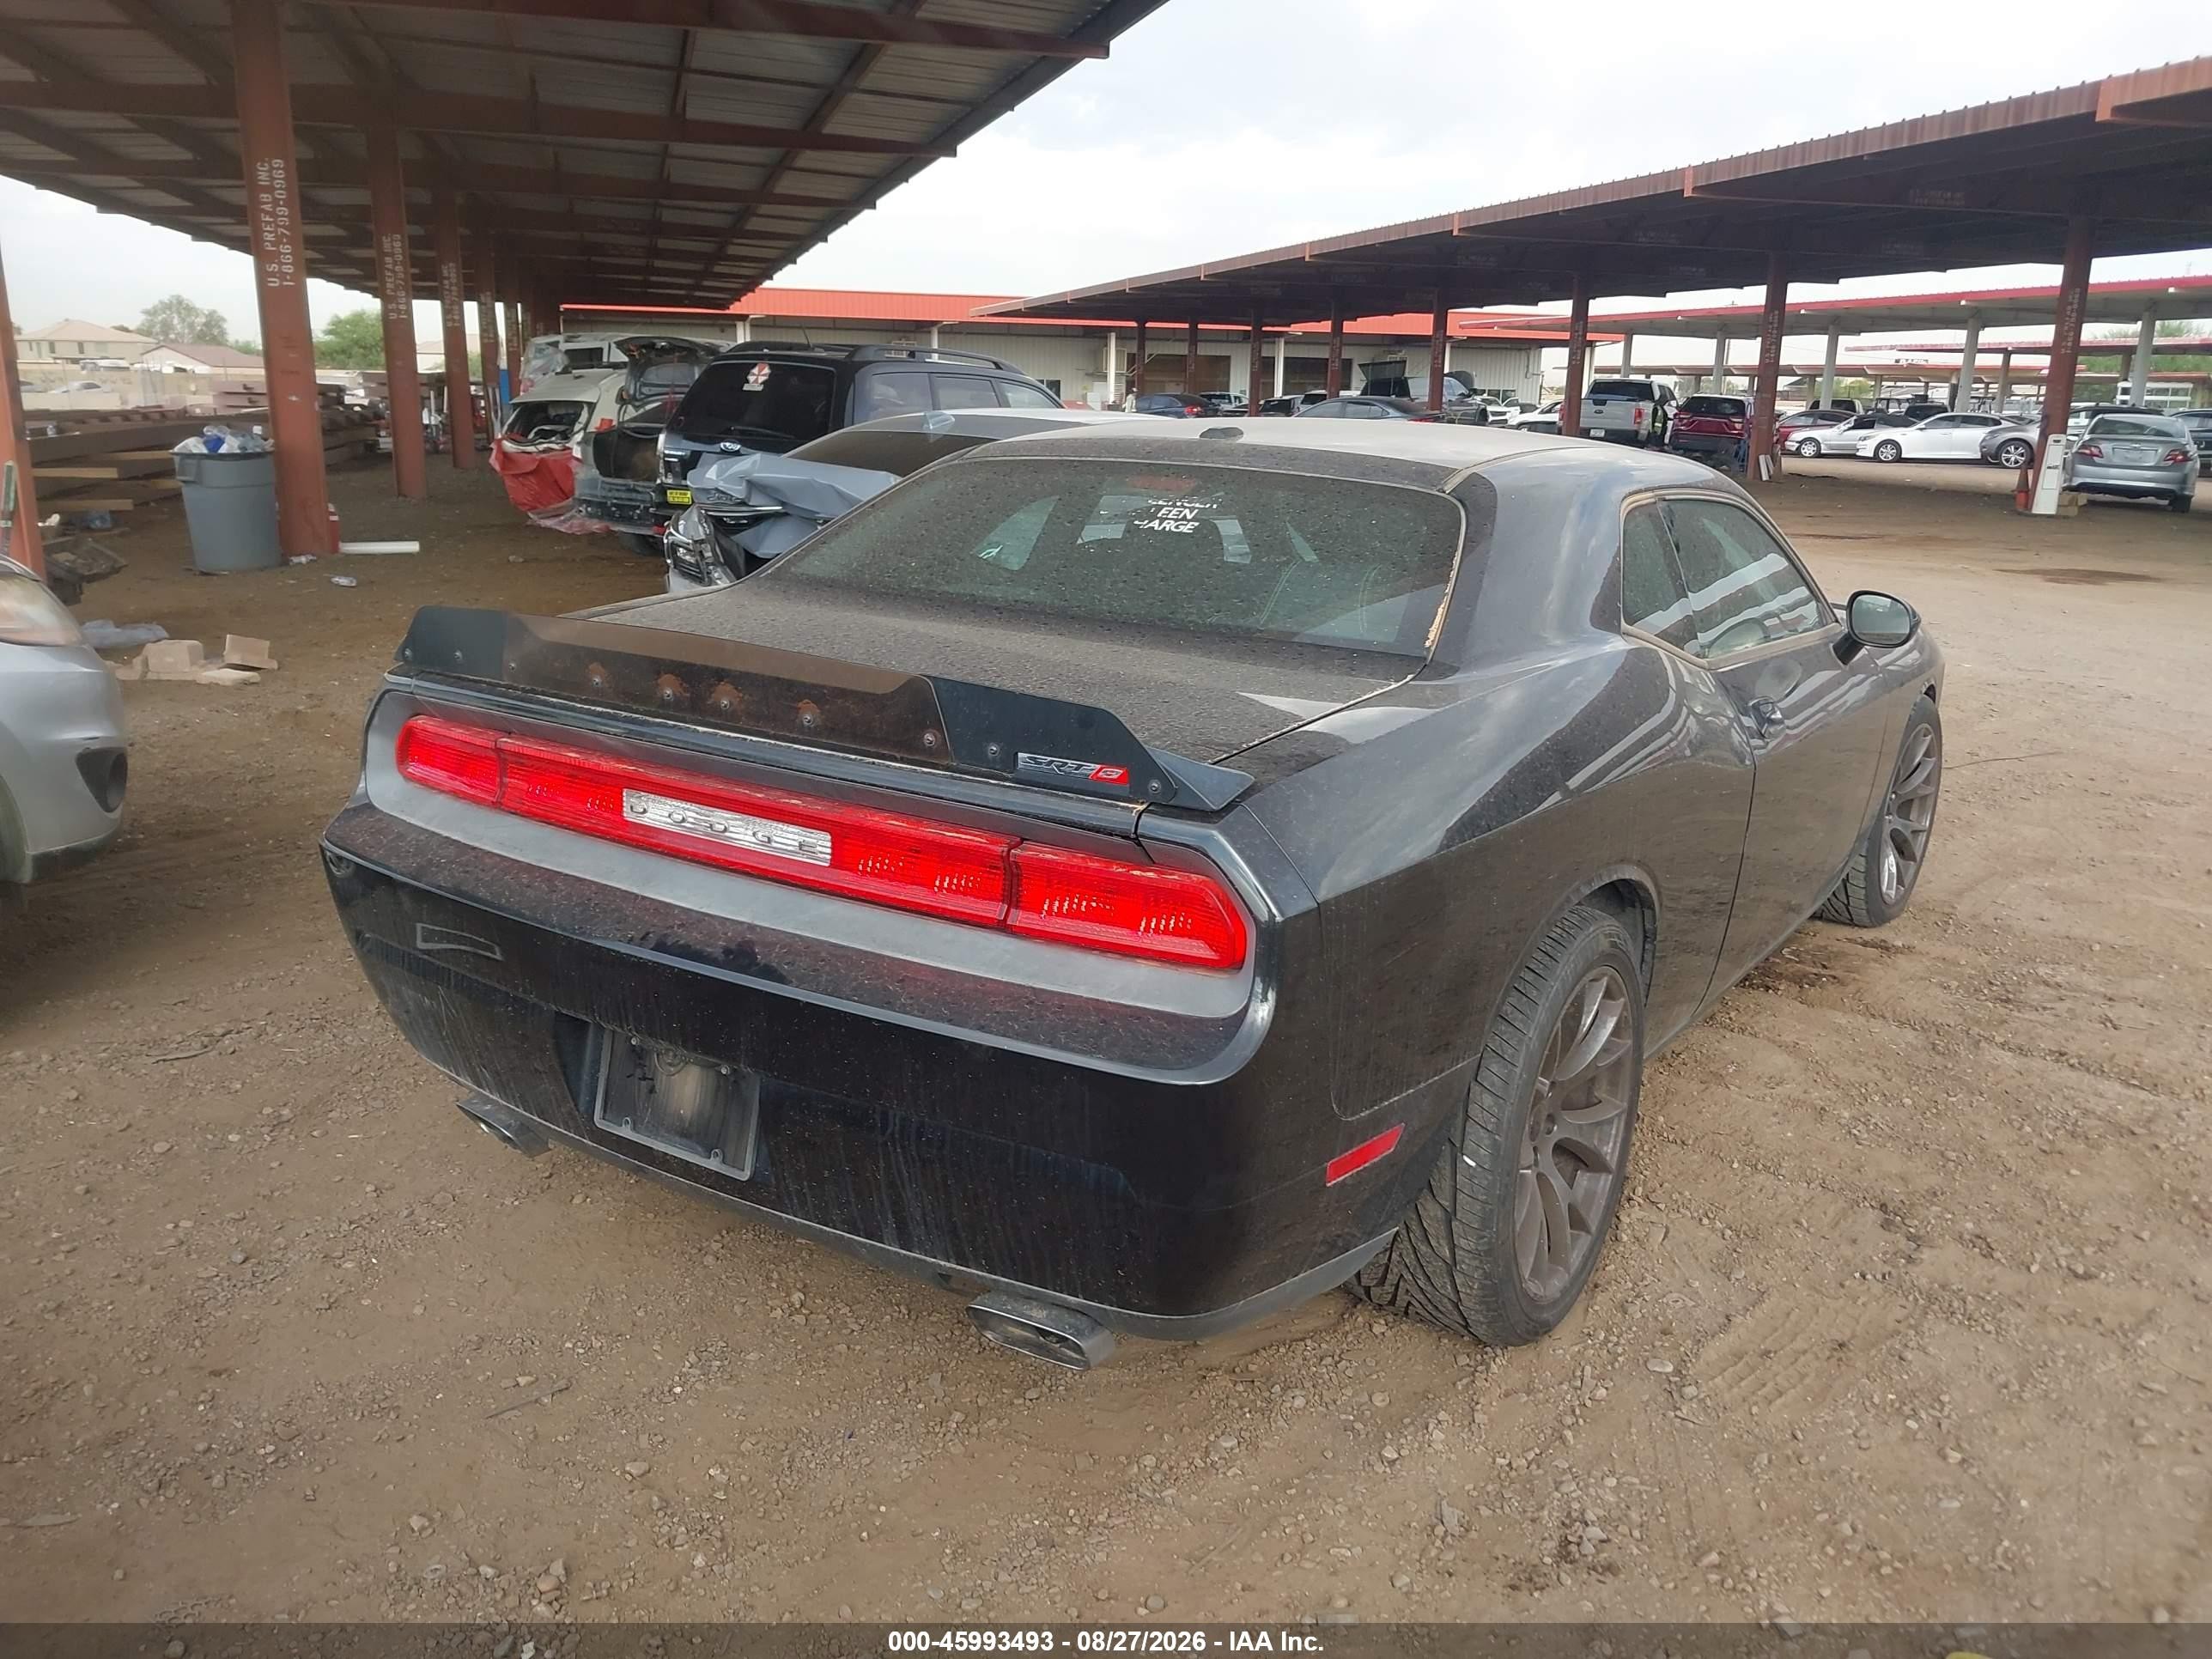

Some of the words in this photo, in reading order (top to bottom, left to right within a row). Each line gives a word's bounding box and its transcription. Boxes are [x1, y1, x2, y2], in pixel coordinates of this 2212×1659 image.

[256, 158, 270, 185] INC.
[259, 193, 277, 251] PREFAB
[271, 158, 295, 286] 1-866-799-0969
[266, 258, 280, 287] U.S.
[629, 793, 819, 855] DODGE
